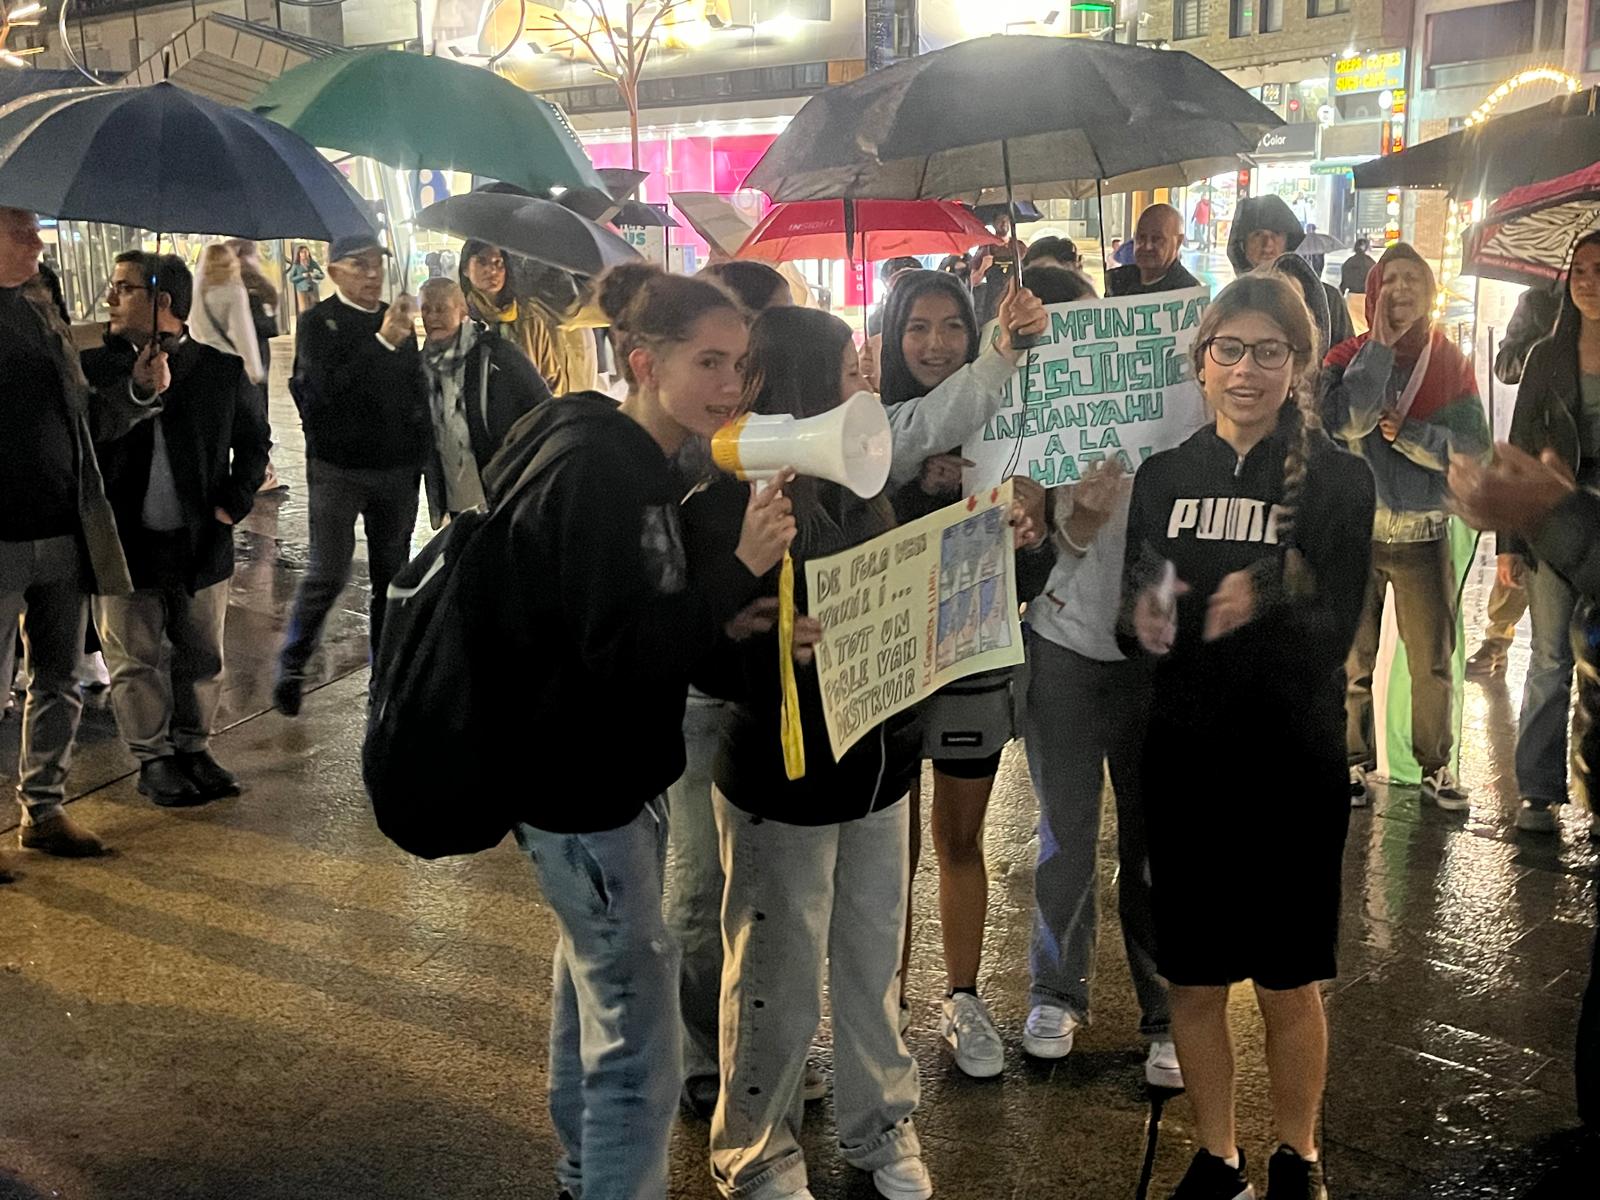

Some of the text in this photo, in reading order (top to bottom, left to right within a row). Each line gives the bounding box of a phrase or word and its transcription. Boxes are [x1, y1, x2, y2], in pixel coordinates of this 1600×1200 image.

[1262, 133, 1287, 148] Color
[1038, 297, 1210, 345] MPUNITAT
[1069, 337, 1191, 395] JUSTÍC
[1043, 427, 1122, 456] A LA
[816, 566, 841, 604] DE
[834, 625, 875, 666] TOT
[880, 609, 910, 645] UN
[876, 636, 917, 677] VAN
